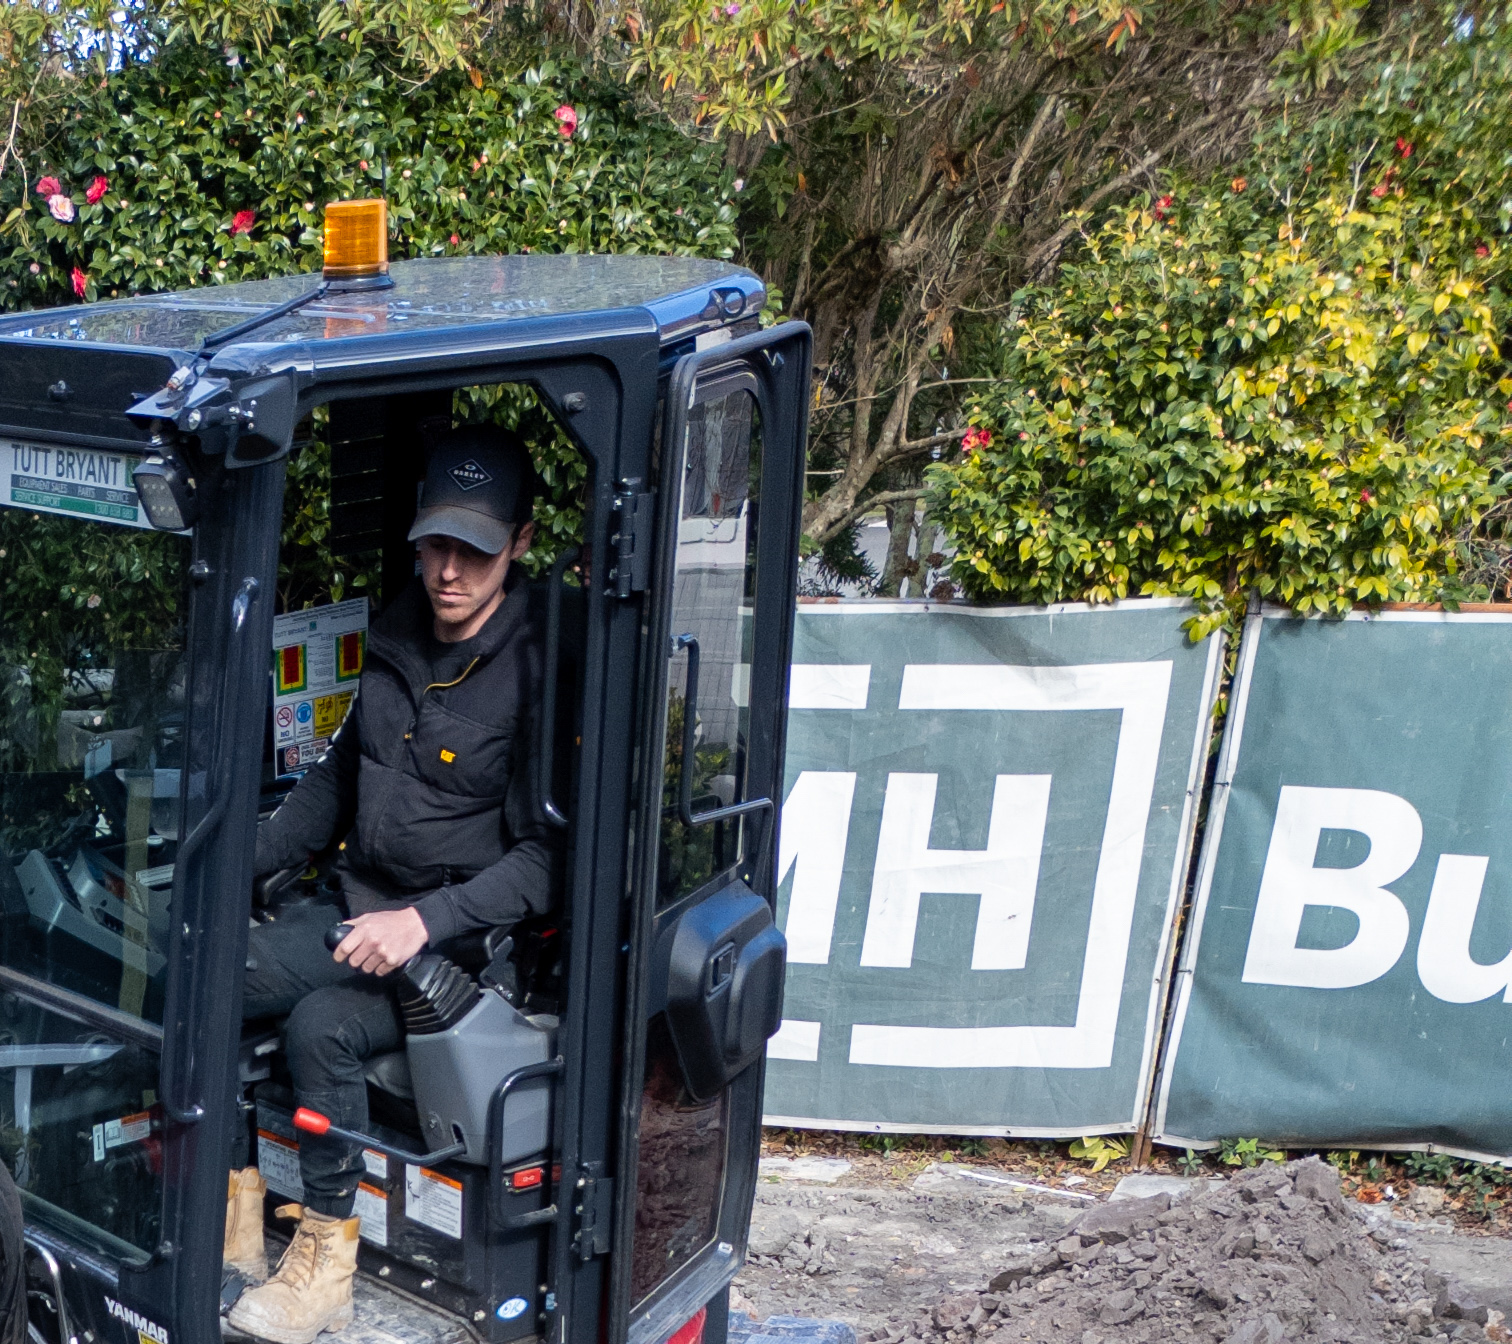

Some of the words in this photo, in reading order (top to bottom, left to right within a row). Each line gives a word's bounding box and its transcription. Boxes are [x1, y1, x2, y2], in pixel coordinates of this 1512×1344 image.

[11, 443, 51, 476] TUTT
[55, 449, 121, 486] BRYANT
[14, 490, 36, 504] SERVICE
[37, 494, 61, 507] SUPPORT
[19, 476, 49, 492] EQUIPMENT
[51, 483, 68, 494] SALES
[77, 486, 96, 498] PARTS
[106, 490, 129, 503] SERVICE
[104, 1295, 169, 1344] YANMAR
